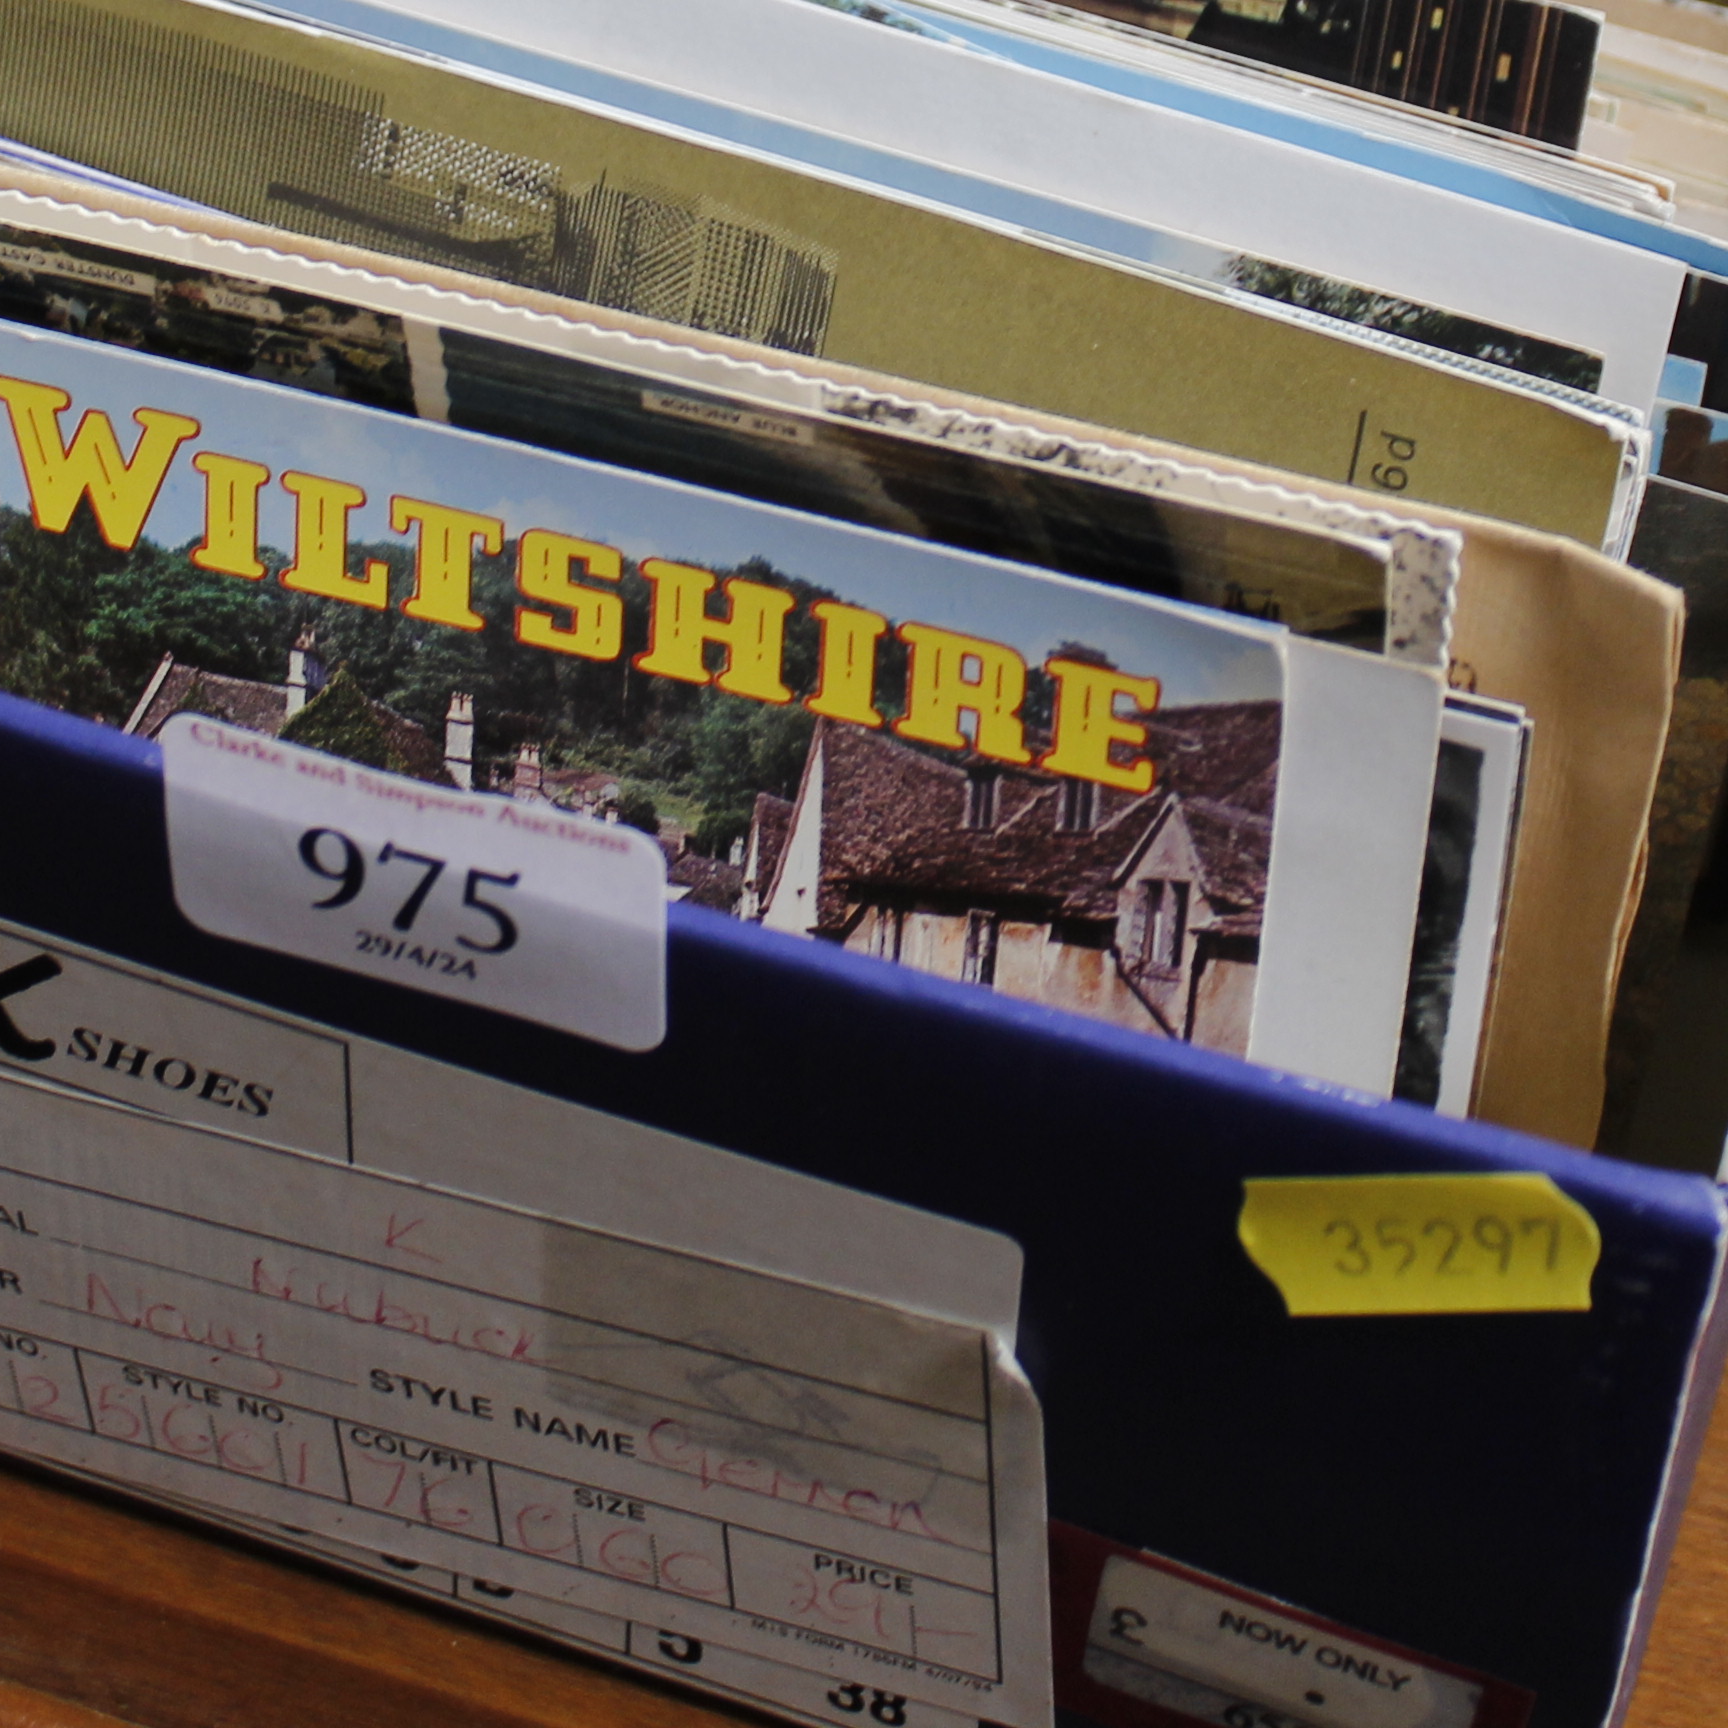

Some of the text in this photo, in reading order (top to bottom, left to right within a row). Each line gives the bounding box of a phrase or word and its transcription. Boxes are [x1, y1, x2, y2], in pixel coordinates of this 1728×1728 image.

[55, 254, 137, 286] DUNSTER
[189, 720, 631, 855] Clarke and Simpson Auctions
[297, 826, 520, 956] 975
[355, 929, 478, 981] 29/4/24
[66, 1026, 274, 1118] SHOES
[1323, 1215, 1562, 1278] 35297
[121, 1364, 222, 1408] STYLE
[370, 1368, 637, 1459] STYLE NAME
[350, 1426, 480, 1476] COL/FIT
[572, 1486, 647, 1523] SIZE
[812, 1552, 916, 1597] PRICE
[1108, 1605, 1148, 1646] £
[1218, 1609, 1413, 1695] NOW ONLY
